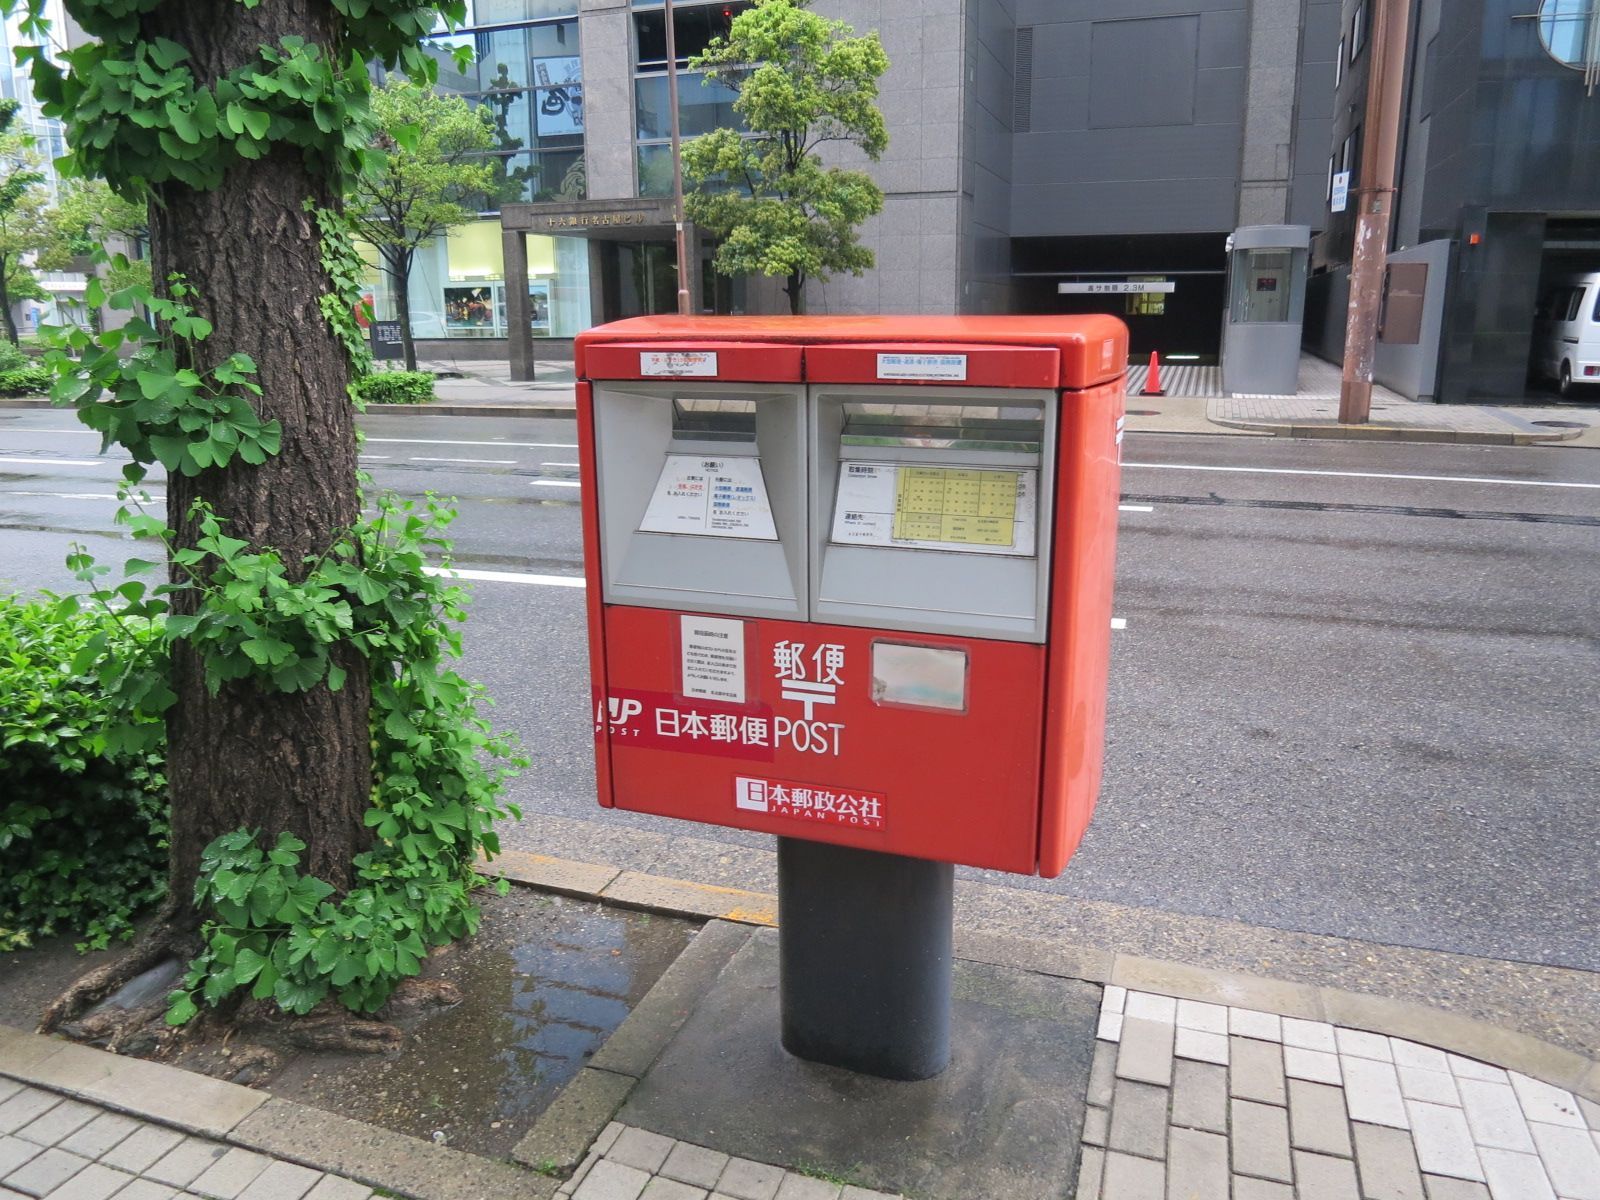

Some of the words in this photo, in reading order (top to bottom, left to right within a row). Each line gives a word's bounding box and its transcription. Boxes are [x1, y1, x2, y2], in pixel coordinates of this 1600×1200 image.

[773, 640, 845, 685] 郵便
[655, 707, 769, 747] 日本郵便
[774, 716, 845, 756] POST
[736, 777, 882, 819] 日本郵政公社
[771, 805, 826, 820] JAPAN
